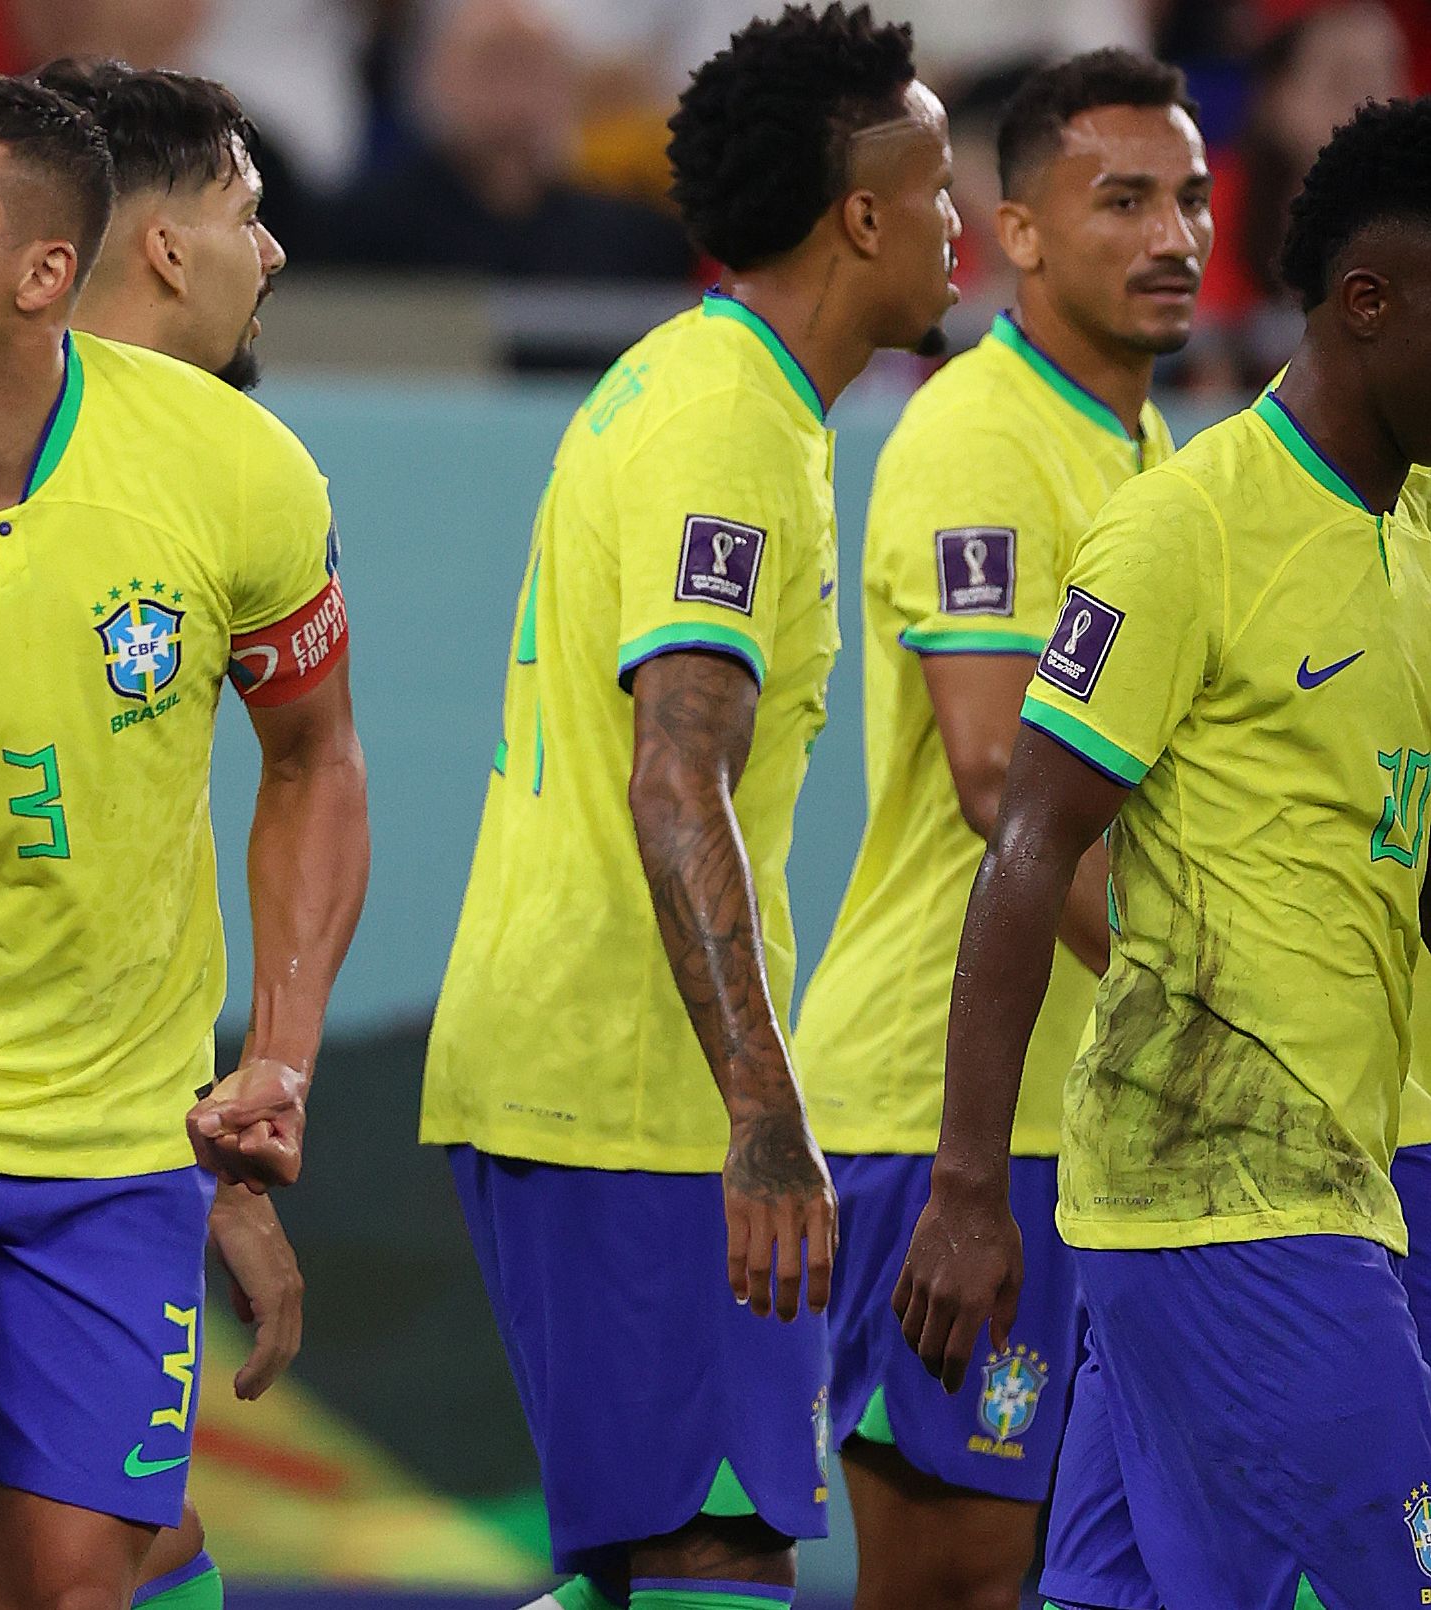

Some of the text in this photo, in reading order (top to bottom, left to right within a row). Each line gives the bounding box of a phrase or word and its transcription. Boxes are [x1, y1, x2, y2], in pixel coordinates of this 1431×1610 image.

[128, 640, 160, 656] CBF
[297, 635, 330, 677] FOR
[110, 692, 181, 735] BRASIL
[2, 743, 70, 860] 3
[1370, 746, 1431, 869] 20
[148, 1301, 198, 1433] 3
